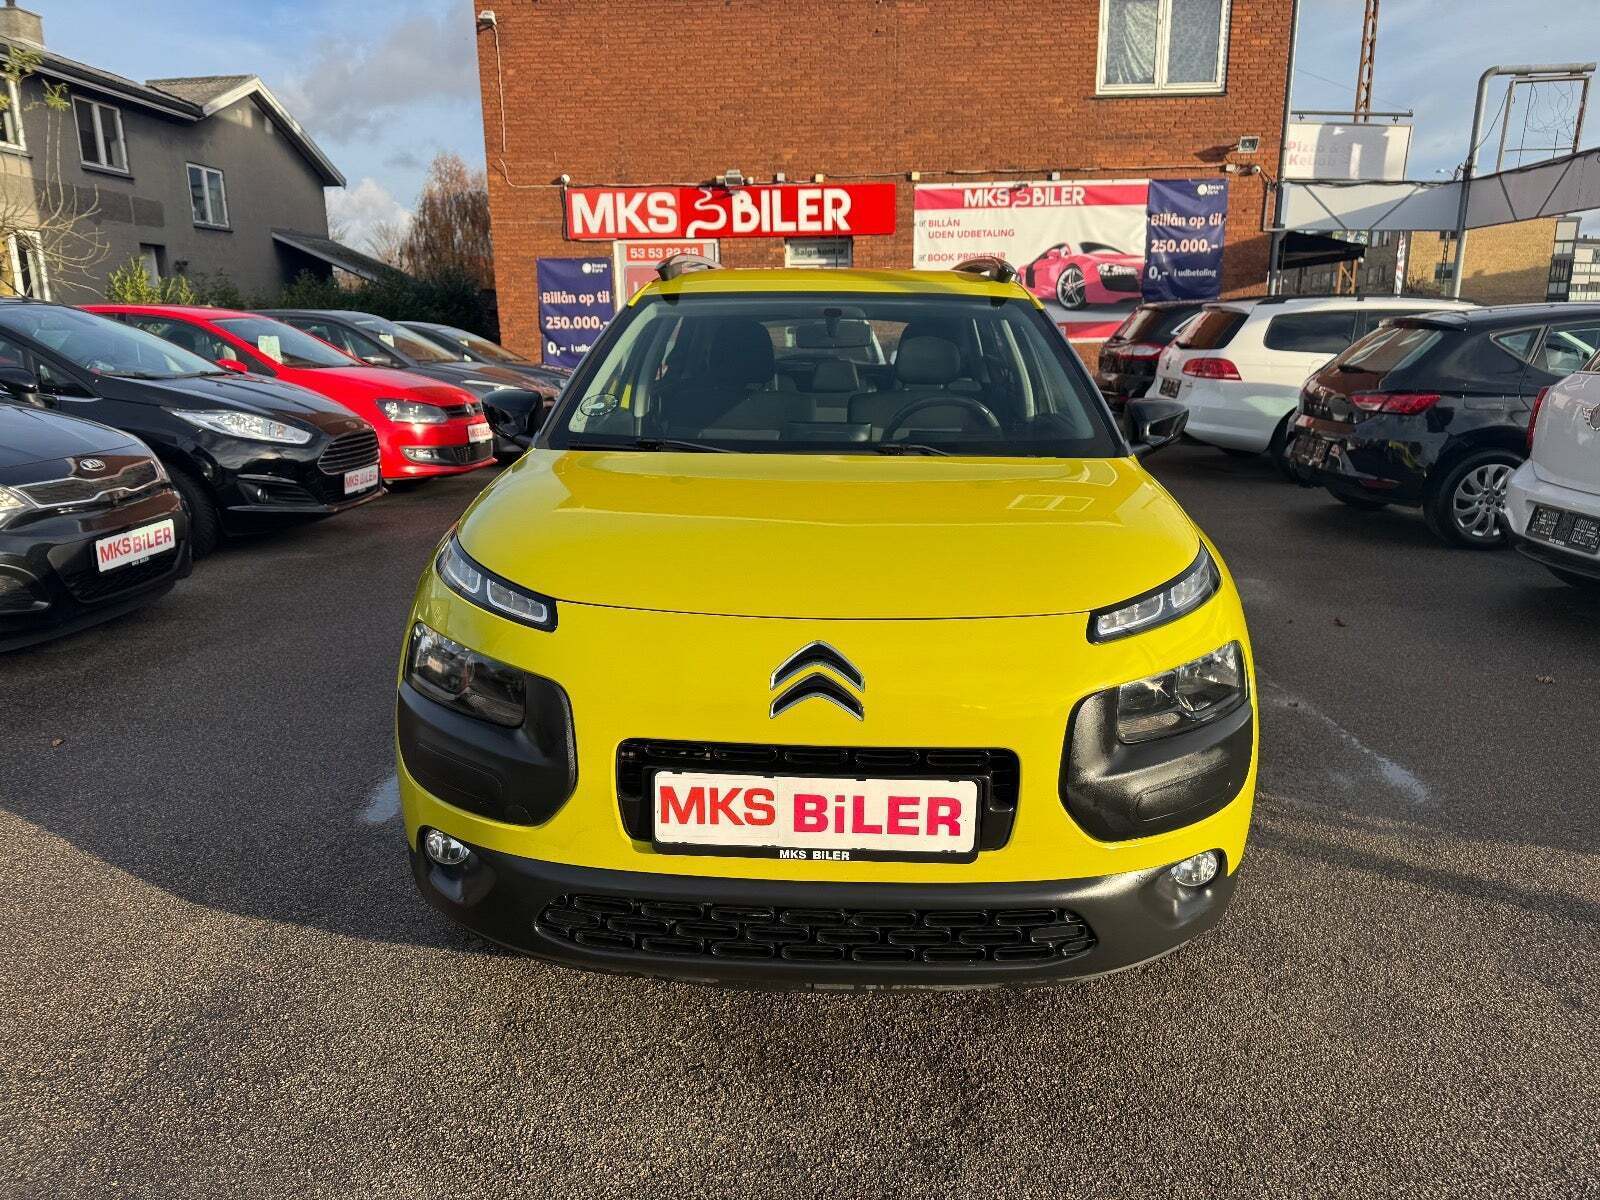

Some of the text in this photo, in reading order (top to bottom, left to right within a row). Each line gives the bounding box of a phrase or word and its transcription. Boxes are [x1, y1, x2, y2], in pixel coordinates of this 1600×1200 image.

[964, 186, 1086, 208] MKS BILER
[571, 189, 852, 234] MKS BILER
[928, 217, 961, 228] BILLÅN
[1151, 213, 1222, 230] Billån op til
[928, 228, 1015, 240] UDEN UDBETALING
[630, 247, 646, 259] 53
[648, 247, 664, 259] 53
[1150, 239, 1218, 254] 250.000,-
[927, 253, 954, 263] BOOK
[1178, 268, 1217, 278] udbetaling
[542, 290, 610, 307] Billån op til
[100, 527, 172, 563] MKS BiLER
[659, 786, 962, 836] MKS BiLER
[779, 849, 807, 859] MKS
